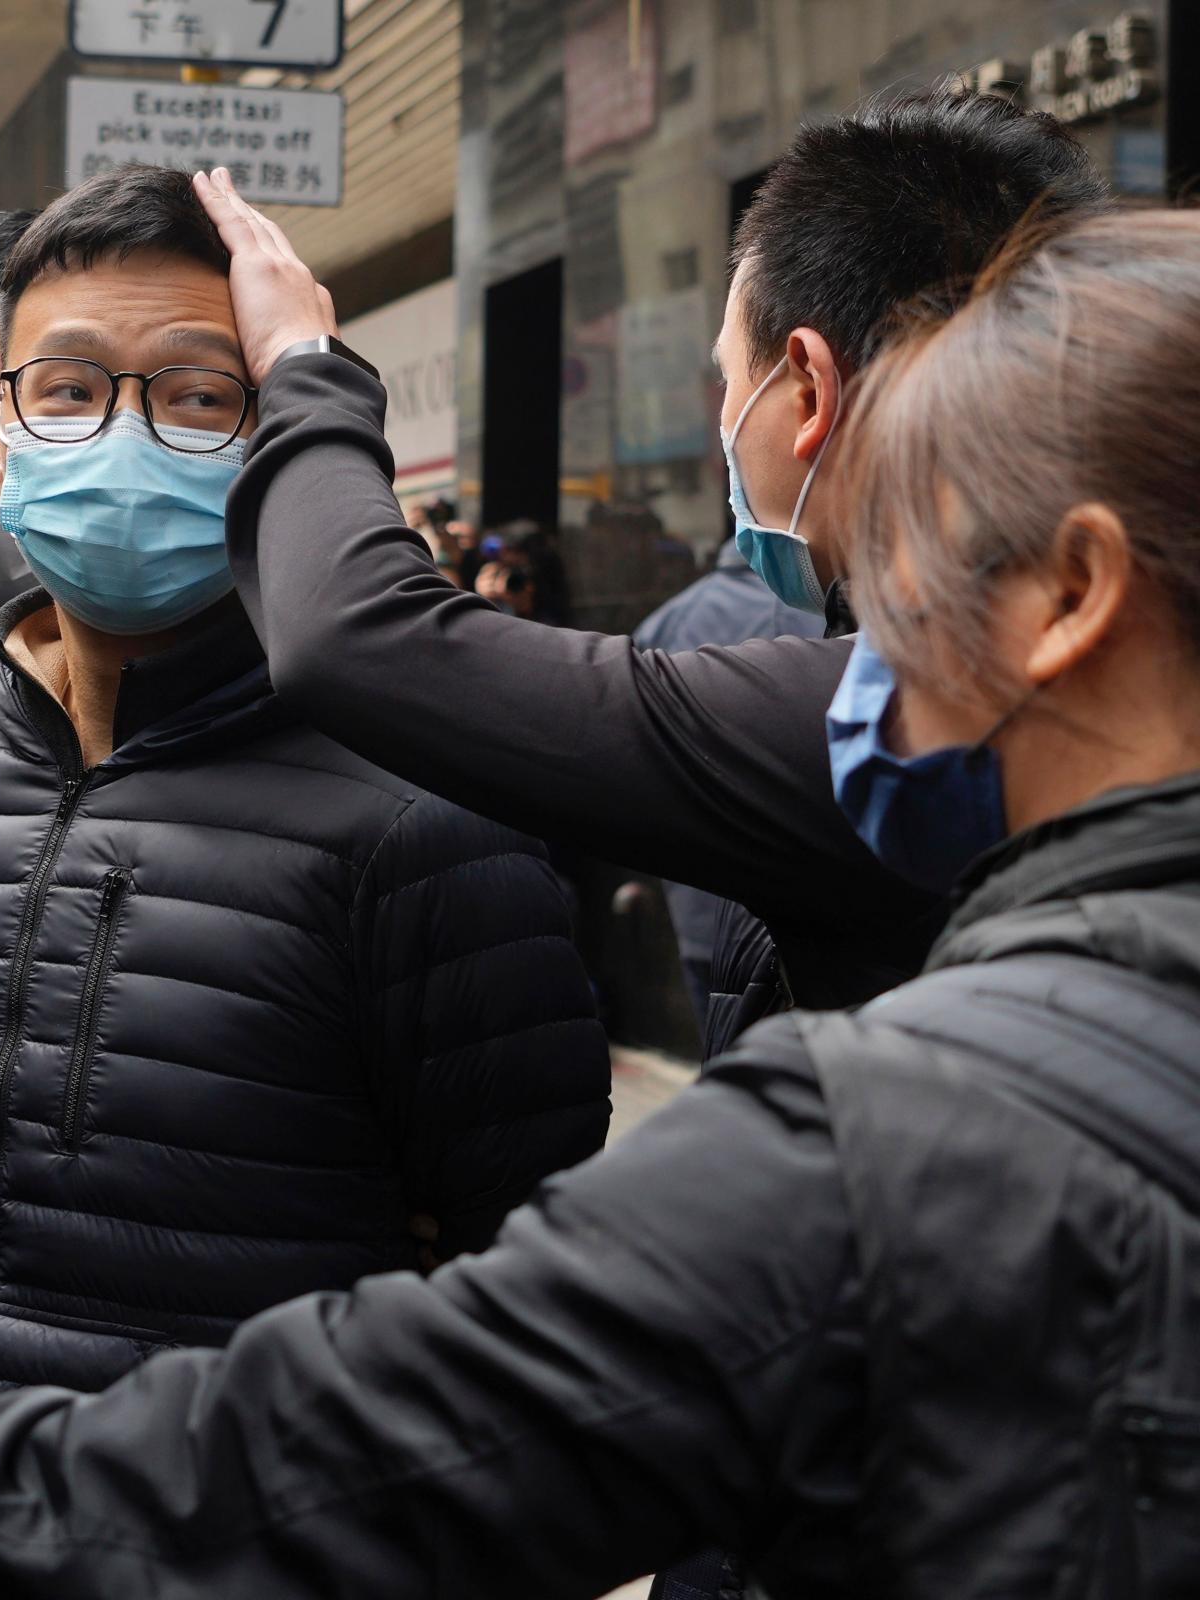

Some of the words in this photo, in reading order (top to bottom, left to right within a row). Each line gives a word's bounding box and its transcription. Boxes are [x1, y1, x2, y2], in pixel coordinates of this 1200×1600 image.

[129, 10, 202, 48] 下午
[249, 0, 289, 48] 7
[134, 91, 225, 124] Except
[233, 97, 283, 122] taxi
[97, 117, 151, 146] pick
[161, 121, 268, 153] up/drop
[274, 129, 313, 150] off
